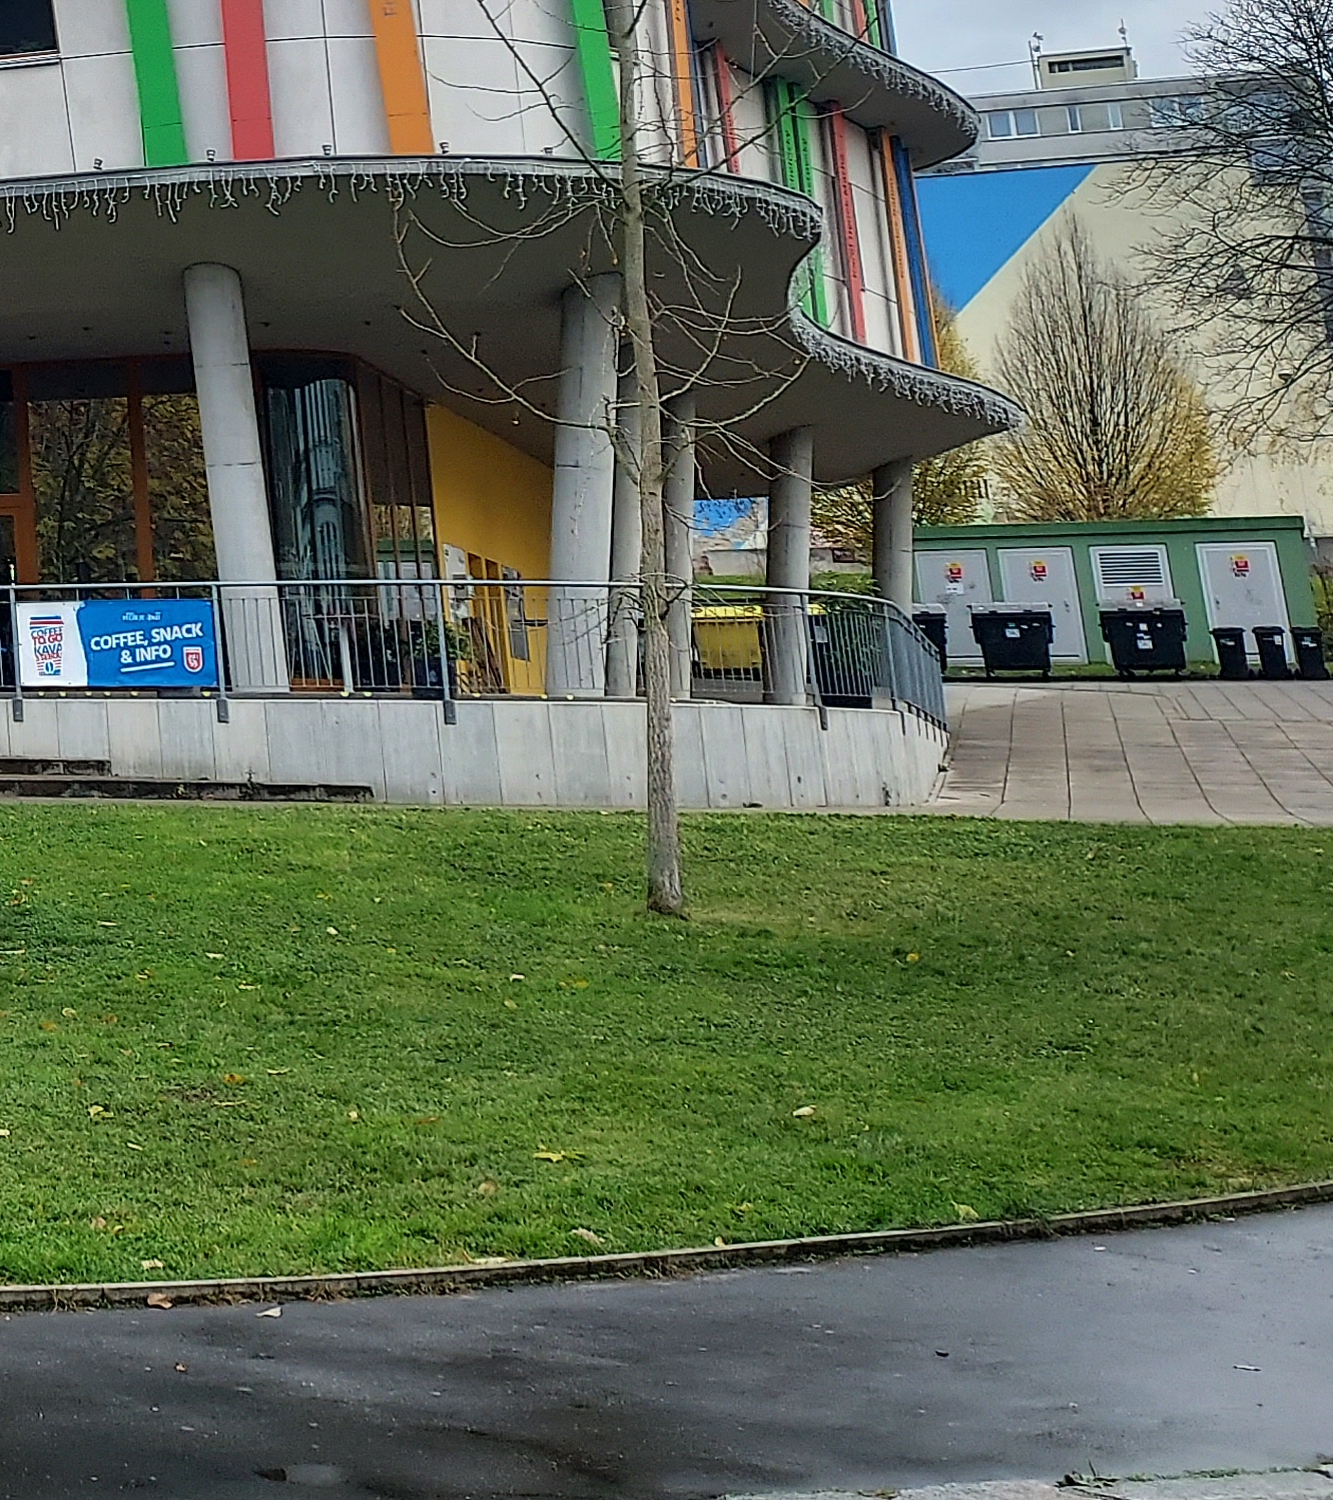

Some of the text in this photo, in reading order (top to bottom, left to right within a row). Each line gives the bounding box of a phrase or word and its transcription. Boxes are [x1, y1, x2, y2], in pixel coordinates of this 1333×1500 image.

[32, 633, 63, 645] TO GO
[90, 622, 204, 650] COFFEE, SNACK
[119, 644, 172, 664] & INFO
